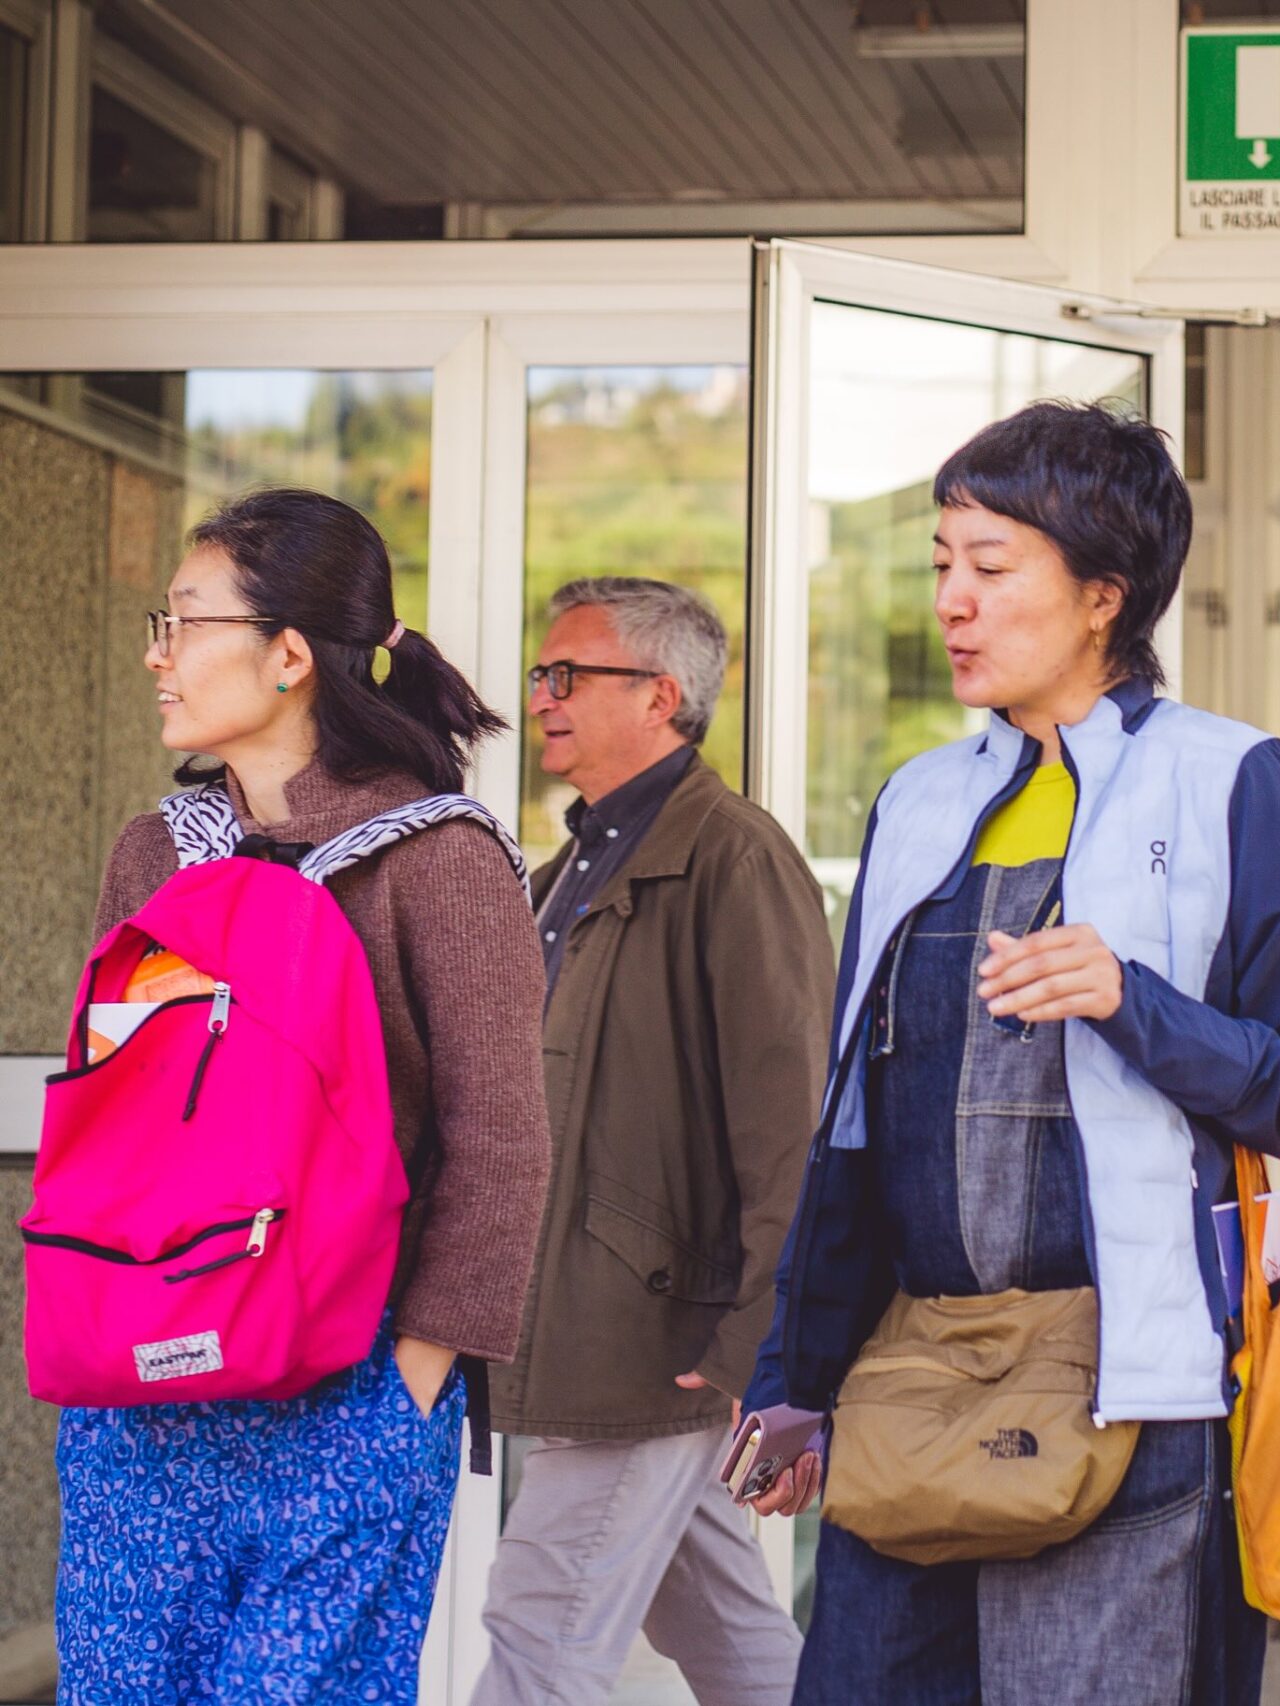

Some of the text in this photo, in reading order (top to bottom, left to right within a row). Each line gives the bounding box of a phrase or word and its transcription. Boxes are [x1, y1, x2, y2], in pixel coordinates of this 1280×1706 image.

[1190, 187, 1264, 207] LASCIARE
[1202, 210, 1213, 229] IL
[997, 1428, 1019, 1440] THE
[979, 1439, 1019, 1450] NORTH
[990, 1449, 1020, 1460] FACE
